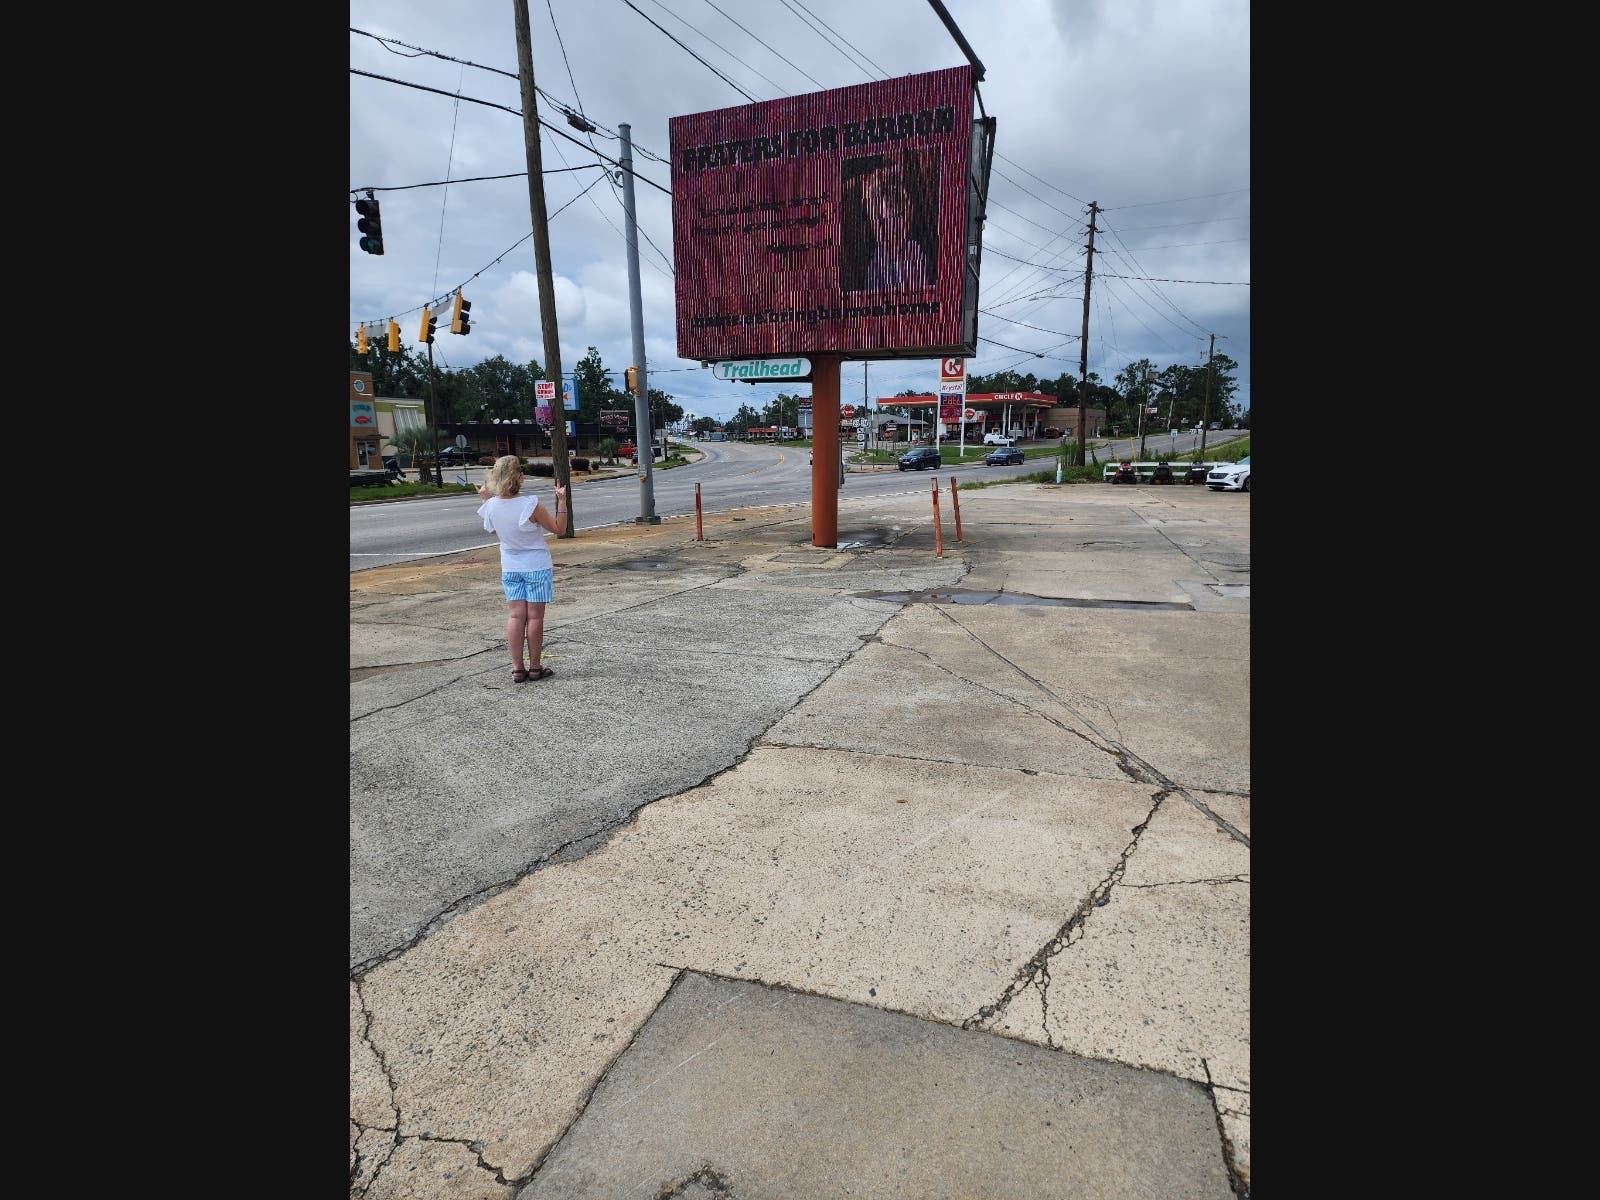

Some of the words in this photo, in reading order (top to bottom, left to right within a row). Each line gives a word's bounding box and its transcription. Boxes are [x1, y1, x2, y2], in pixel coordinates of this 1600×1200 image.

[683, 133, 783, 172] PRAYERS
[790, 125, 838, 157] FOR
[722, 360, 802, 378] Trailhead
